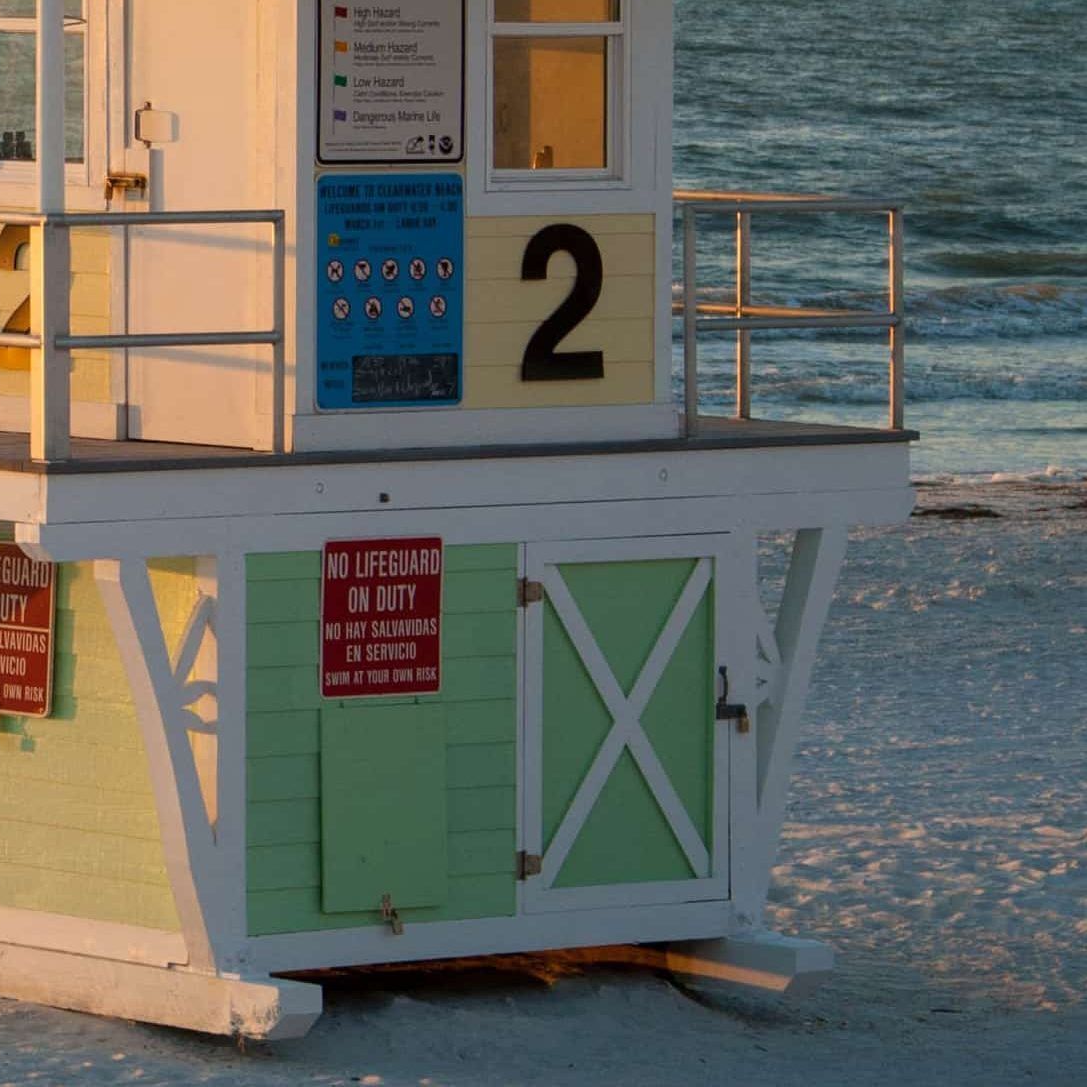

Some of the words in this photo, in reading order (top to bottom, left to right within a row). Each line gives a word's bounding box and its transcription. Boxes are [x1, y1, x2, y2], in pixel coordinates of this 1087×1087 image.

[353, 7, 371, 21] High
[373, 7, 400, 18] Hazard
[353, 41, 386, 53] Medium
[388, 41, 417, 53] Hazard
[353, 77, 370, 87] Low
[373, 76, 404, 87] Hazard
[353, 111, 395, 124] Dangerous
[398, 111, 424, 122] Marine
[426, 111, 440, 122] Life
[521, 223, 604, 382] 2
[327, 552, 348, 579] NO
[356, 549, 440, 578] LIFEGUARD
[348, 586, 369, 613] ON
[377, 584, 416, 612] DUTY
[325, 622, 341, 640] NO
[346, 621, 368, 640] HAY
[371, 617, 437, 639] SALVAVIDAS
[346, 644, 361, 662] EN
[366, 642, 416, 662] SERVICIO
[325, 670, 350, 686] SWIM
[353, 670, 364, 685] AT
[367, 669, 389, 684] YOUR
[393, 668, 412, 683] OWN
[416, 667, 436, 682] RISK
[3, 683, 22, 700] OWN
[24, 686, 44, 702] RISK
